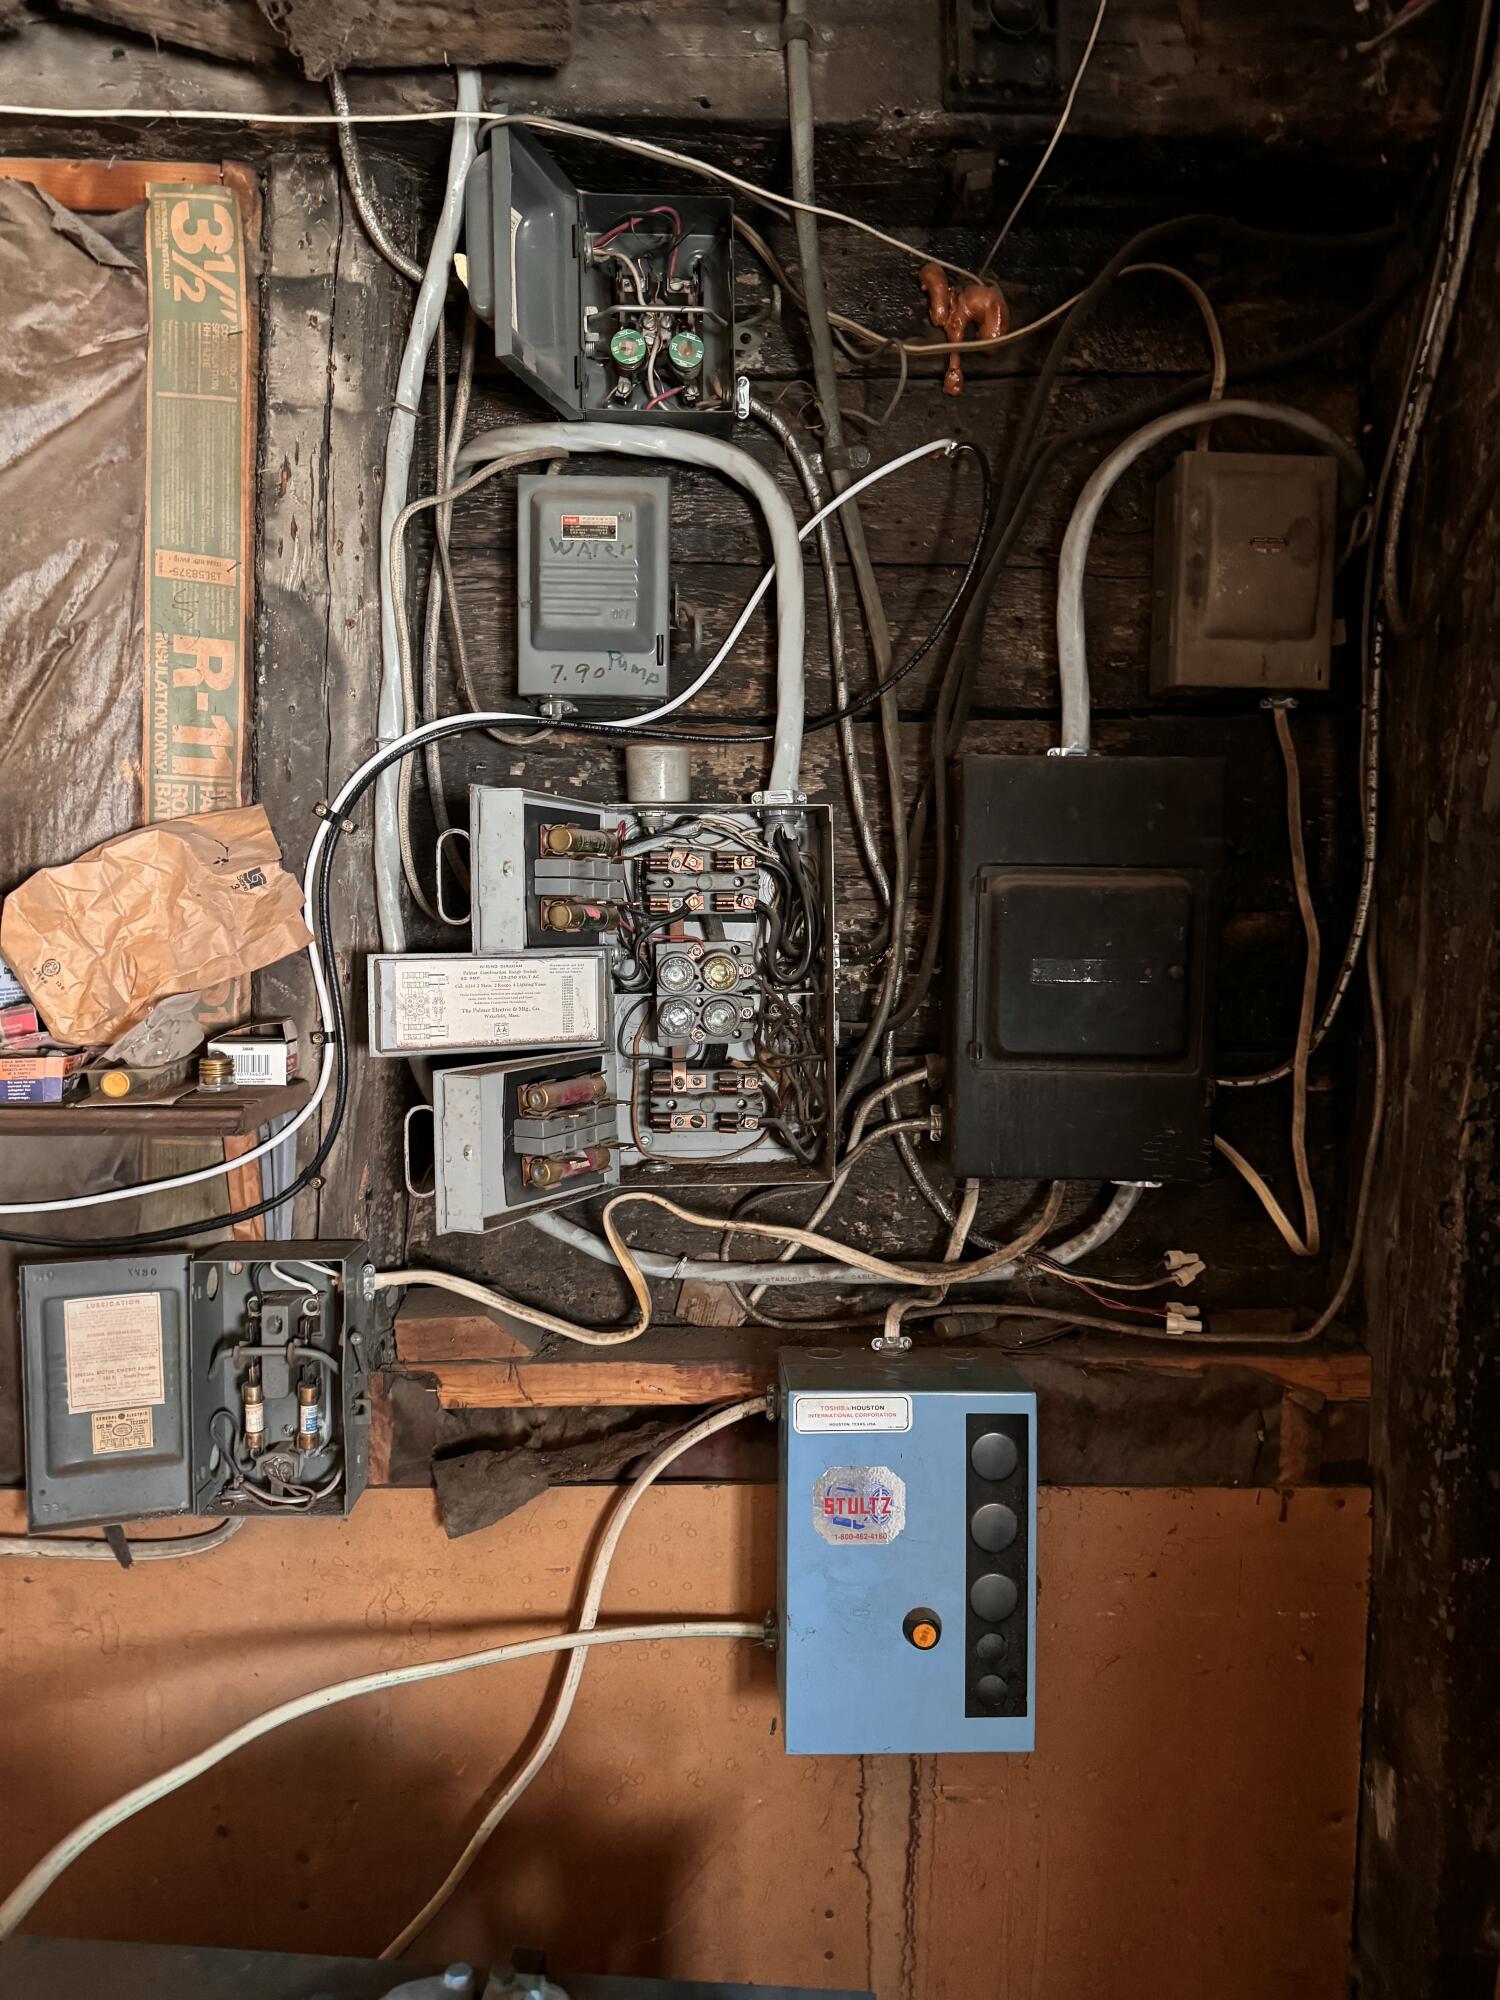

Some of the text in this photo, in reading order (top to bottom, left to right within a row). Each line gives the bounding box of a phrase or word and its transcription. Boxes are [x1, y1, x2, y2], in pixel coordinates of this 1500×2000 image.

[154, 631, 169, 772] INSULATION ONLY
[172, 633, 236, 779] R-11
[86, 1299, 141, 1309] LUBRICATION
[824, 1497, 891, 1514] STULTZ
